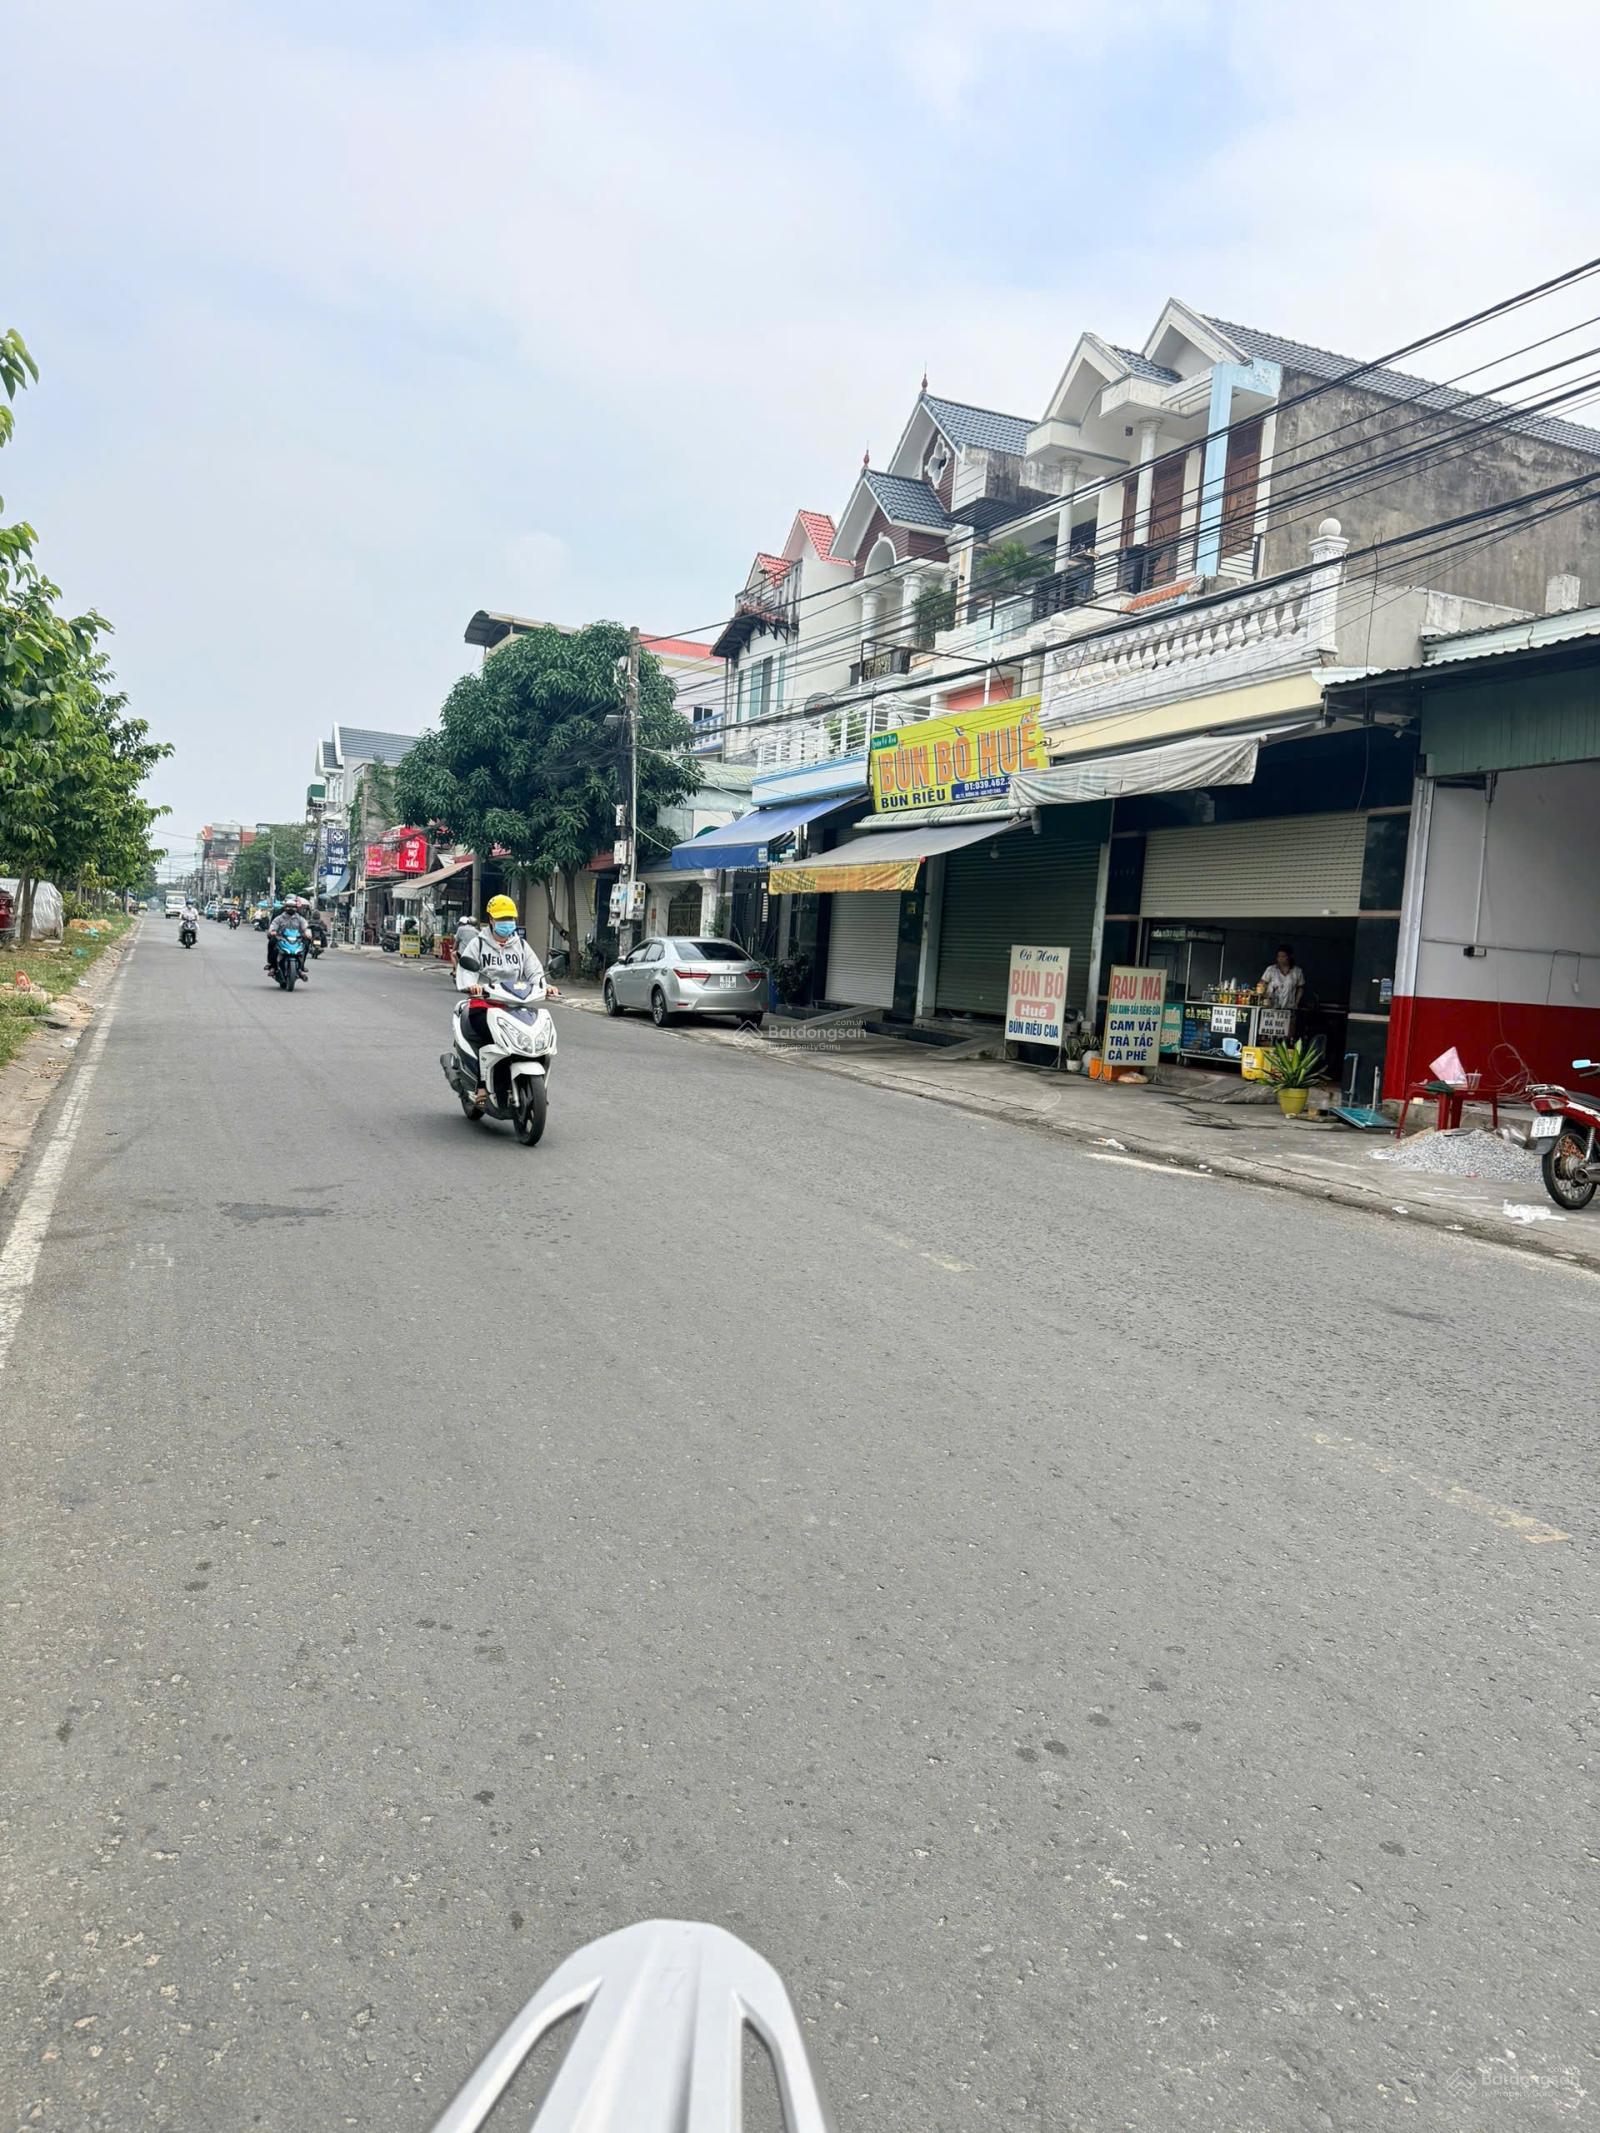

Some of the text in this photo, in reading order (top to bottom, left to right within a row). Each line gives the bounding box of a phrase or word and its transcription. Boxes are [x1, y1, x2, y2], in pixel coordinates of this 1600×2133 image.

[879, 705, 1040, 794] BÚN BÒ HUẾ
[881, 793, 908, 809] BÚN
[912, 788, 946, 804] RIÊU
[1011, 965, 1064, 999] BÚN BÒ
[1112, 972, 1161, 1000] RAU MÁ
[1021, 1004, 1047, 1018] Huế
[1009, 1018, 1058, 1038] BÚN RIÊU CUA
[1110, 1017, 1158, 1032] CAM VẮT
[1110, 1034, 1129, 1047] TRÀ
[1133, 1033, 1154, 1047] TẮC
[1108, 1048, 1147, 1061] CÀ PHÊ
